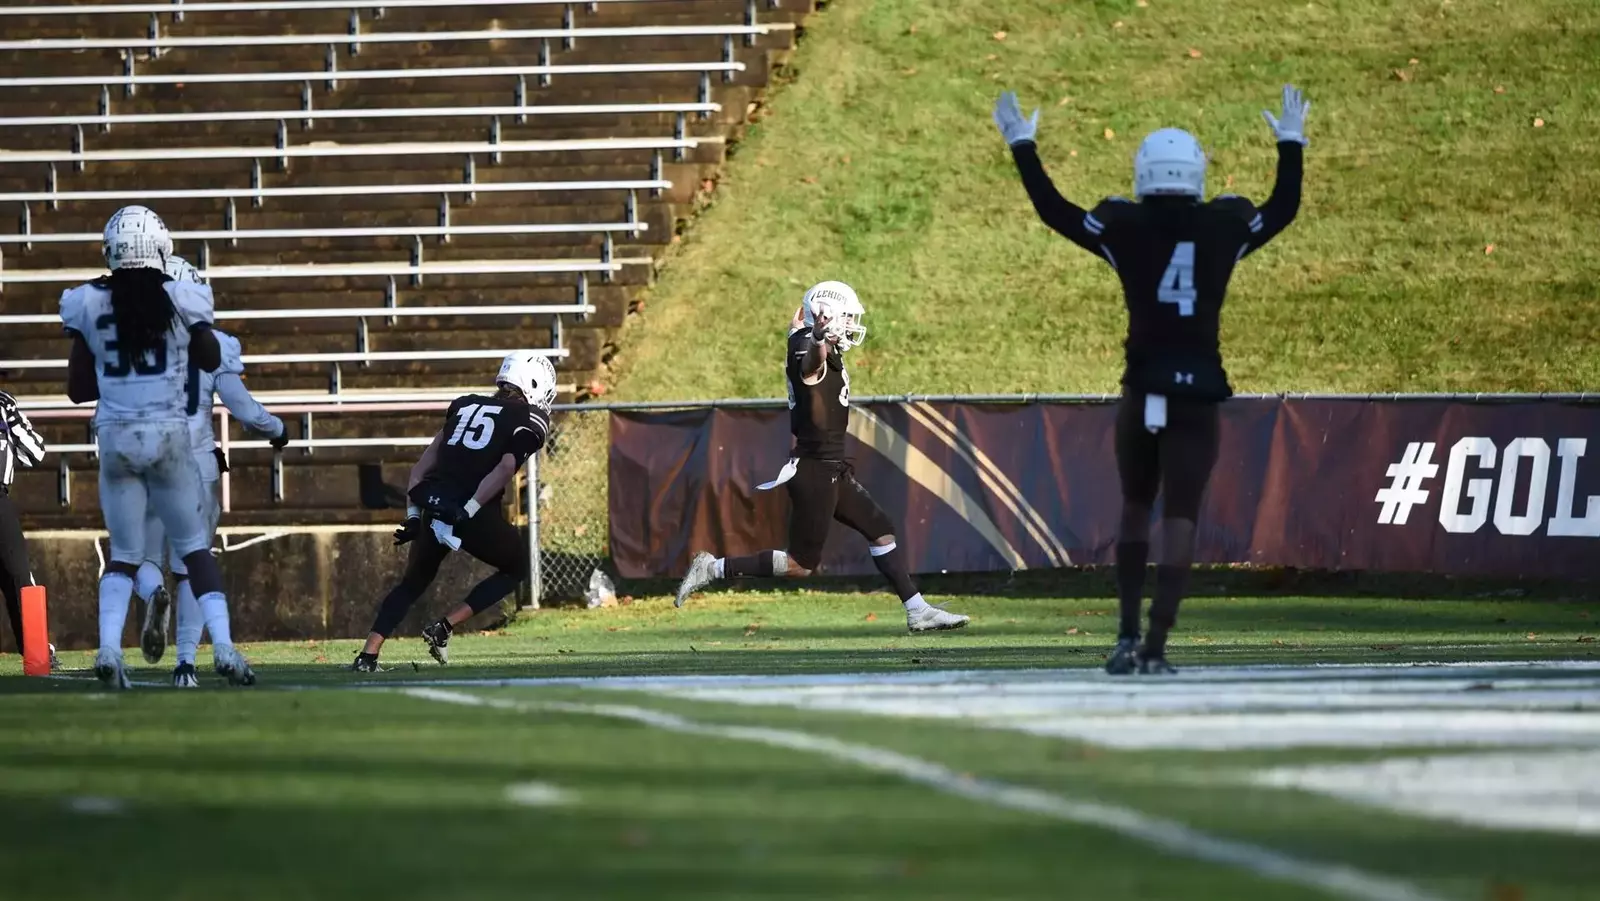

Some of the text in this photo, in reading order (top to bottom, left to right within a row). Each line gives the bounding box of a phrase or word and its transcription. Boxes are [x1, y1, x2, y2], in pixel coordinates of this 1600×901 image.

[1157, 241, 1198, 317] 4
[446, 403, 504, 451] 15
[1374, 436, 1600, 537] #GOL
